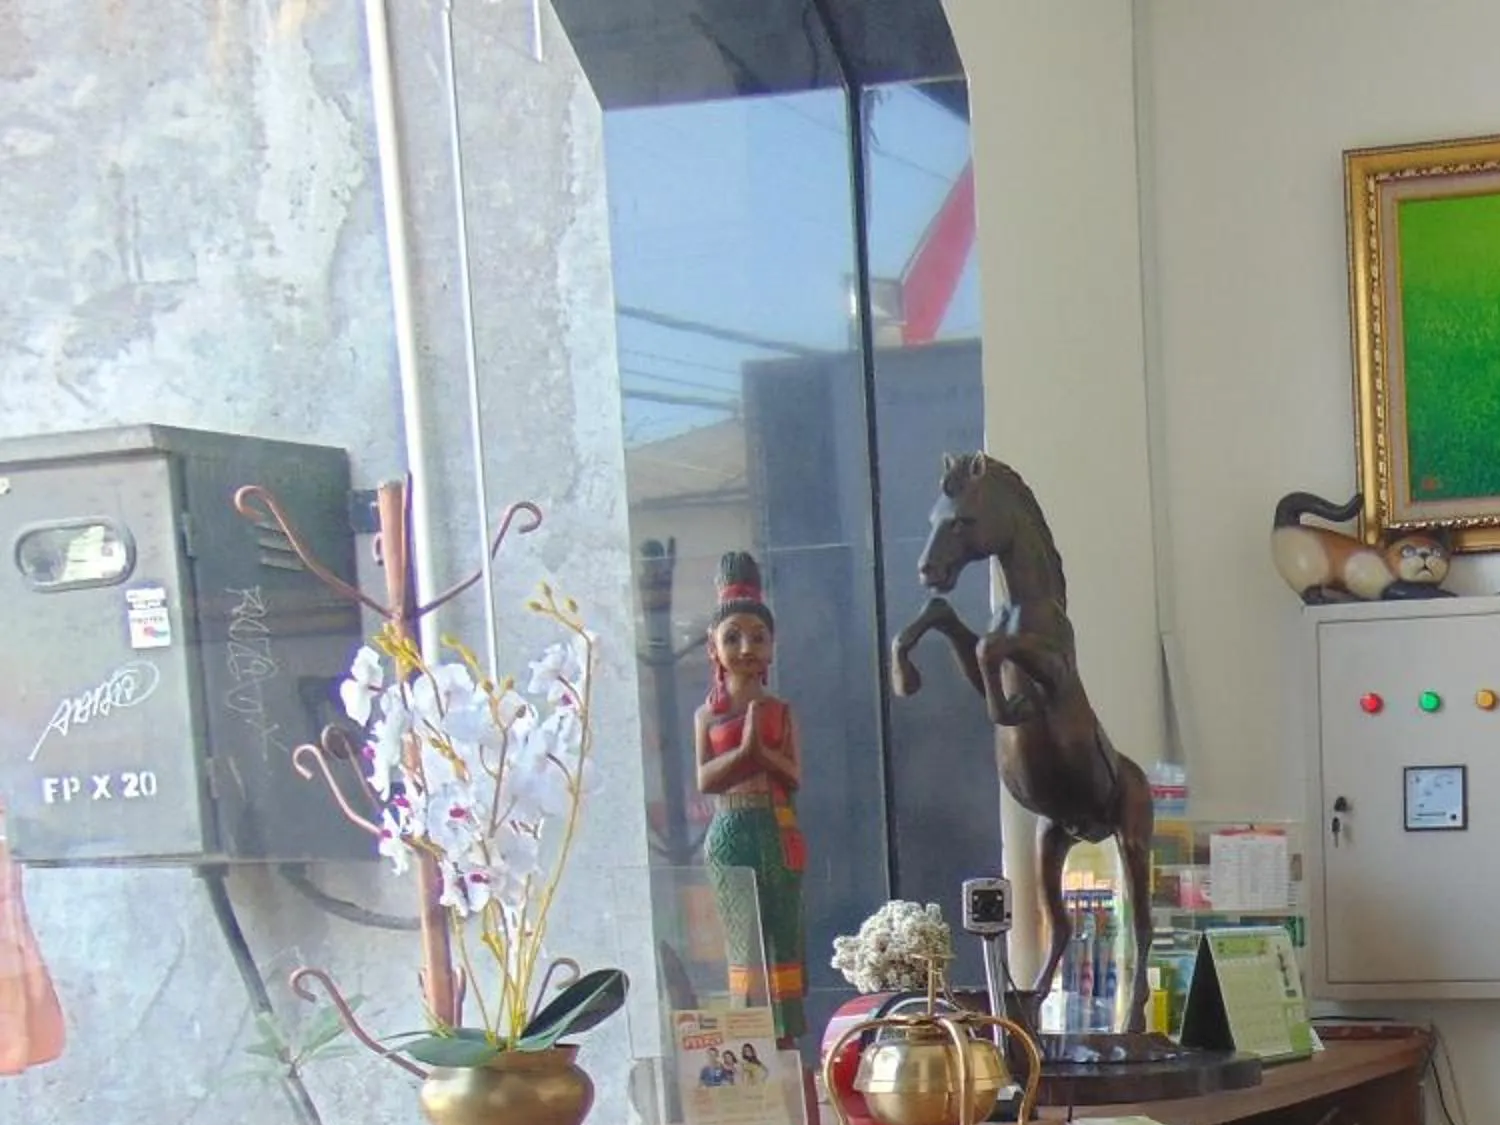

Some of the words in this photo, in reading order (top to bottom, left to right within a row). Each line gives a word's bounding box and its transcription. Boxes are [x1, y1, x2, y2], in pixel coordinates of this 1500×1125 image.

[43, 777, 81, 803] FP
[91, 774, 112, 800] X
[121, 770, 157, 798] 20
